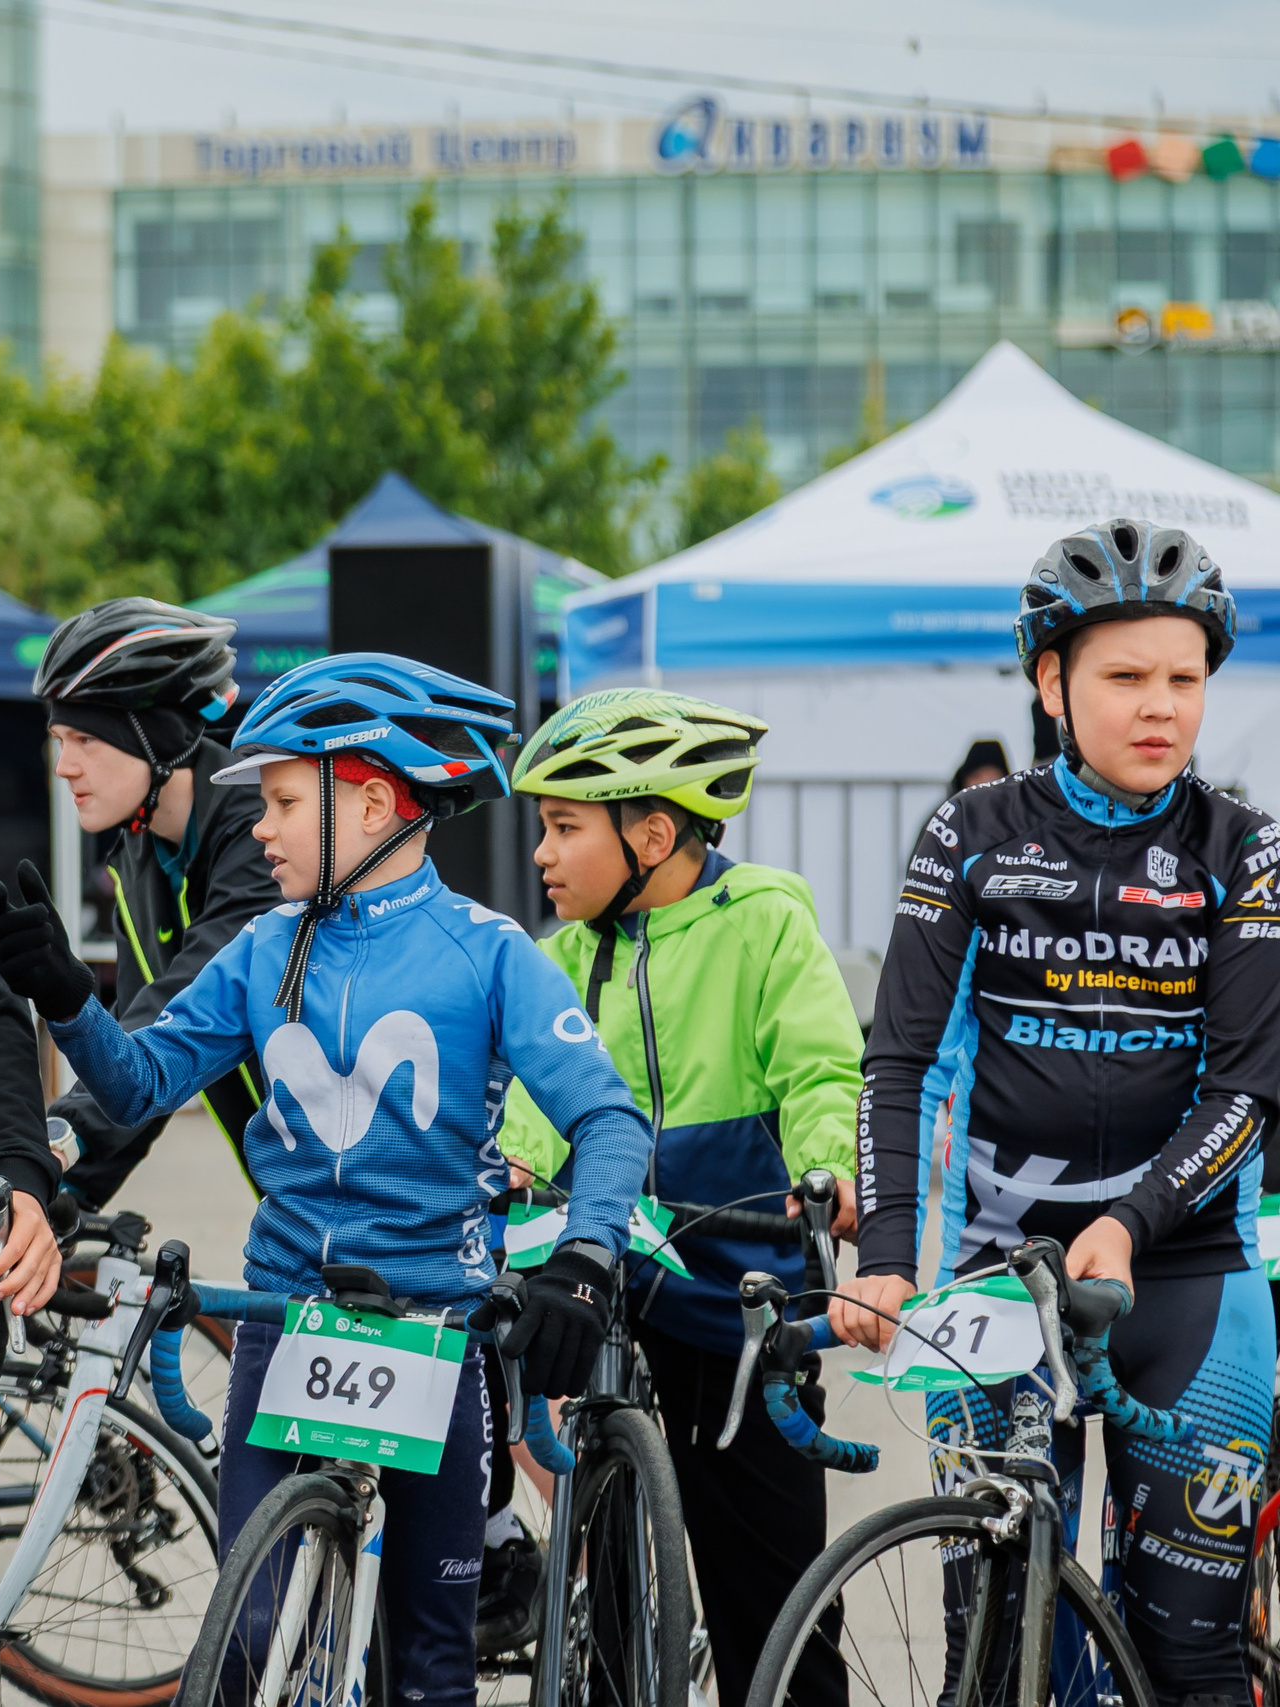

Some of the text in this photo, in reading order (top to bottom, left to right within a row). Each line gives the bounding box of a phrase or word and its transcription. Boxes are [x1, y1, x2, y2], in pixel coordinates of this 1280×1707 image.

[196, 132, 577, 178] Торговый Центр
[324, 725, 393, 750] BIKEBOY
[390, 883, 431, 910] movistar
[1045, 969, 1197, 995] by Italcementi
[1004, 1014, 1198, 1053] Bianchi
[351, 1321, 382, 1337] Звук
[931, 1309, 991, 1355] 61
[306, 1356, 396, 1410] 849
[377, 1446, 396, 1456] 2026
[379, 1438, 400, 1449] 30.05
[1172, 1527, 1247, 1554] by Italcementi
[1139, 1535, 1243, 1580] Bianchi
